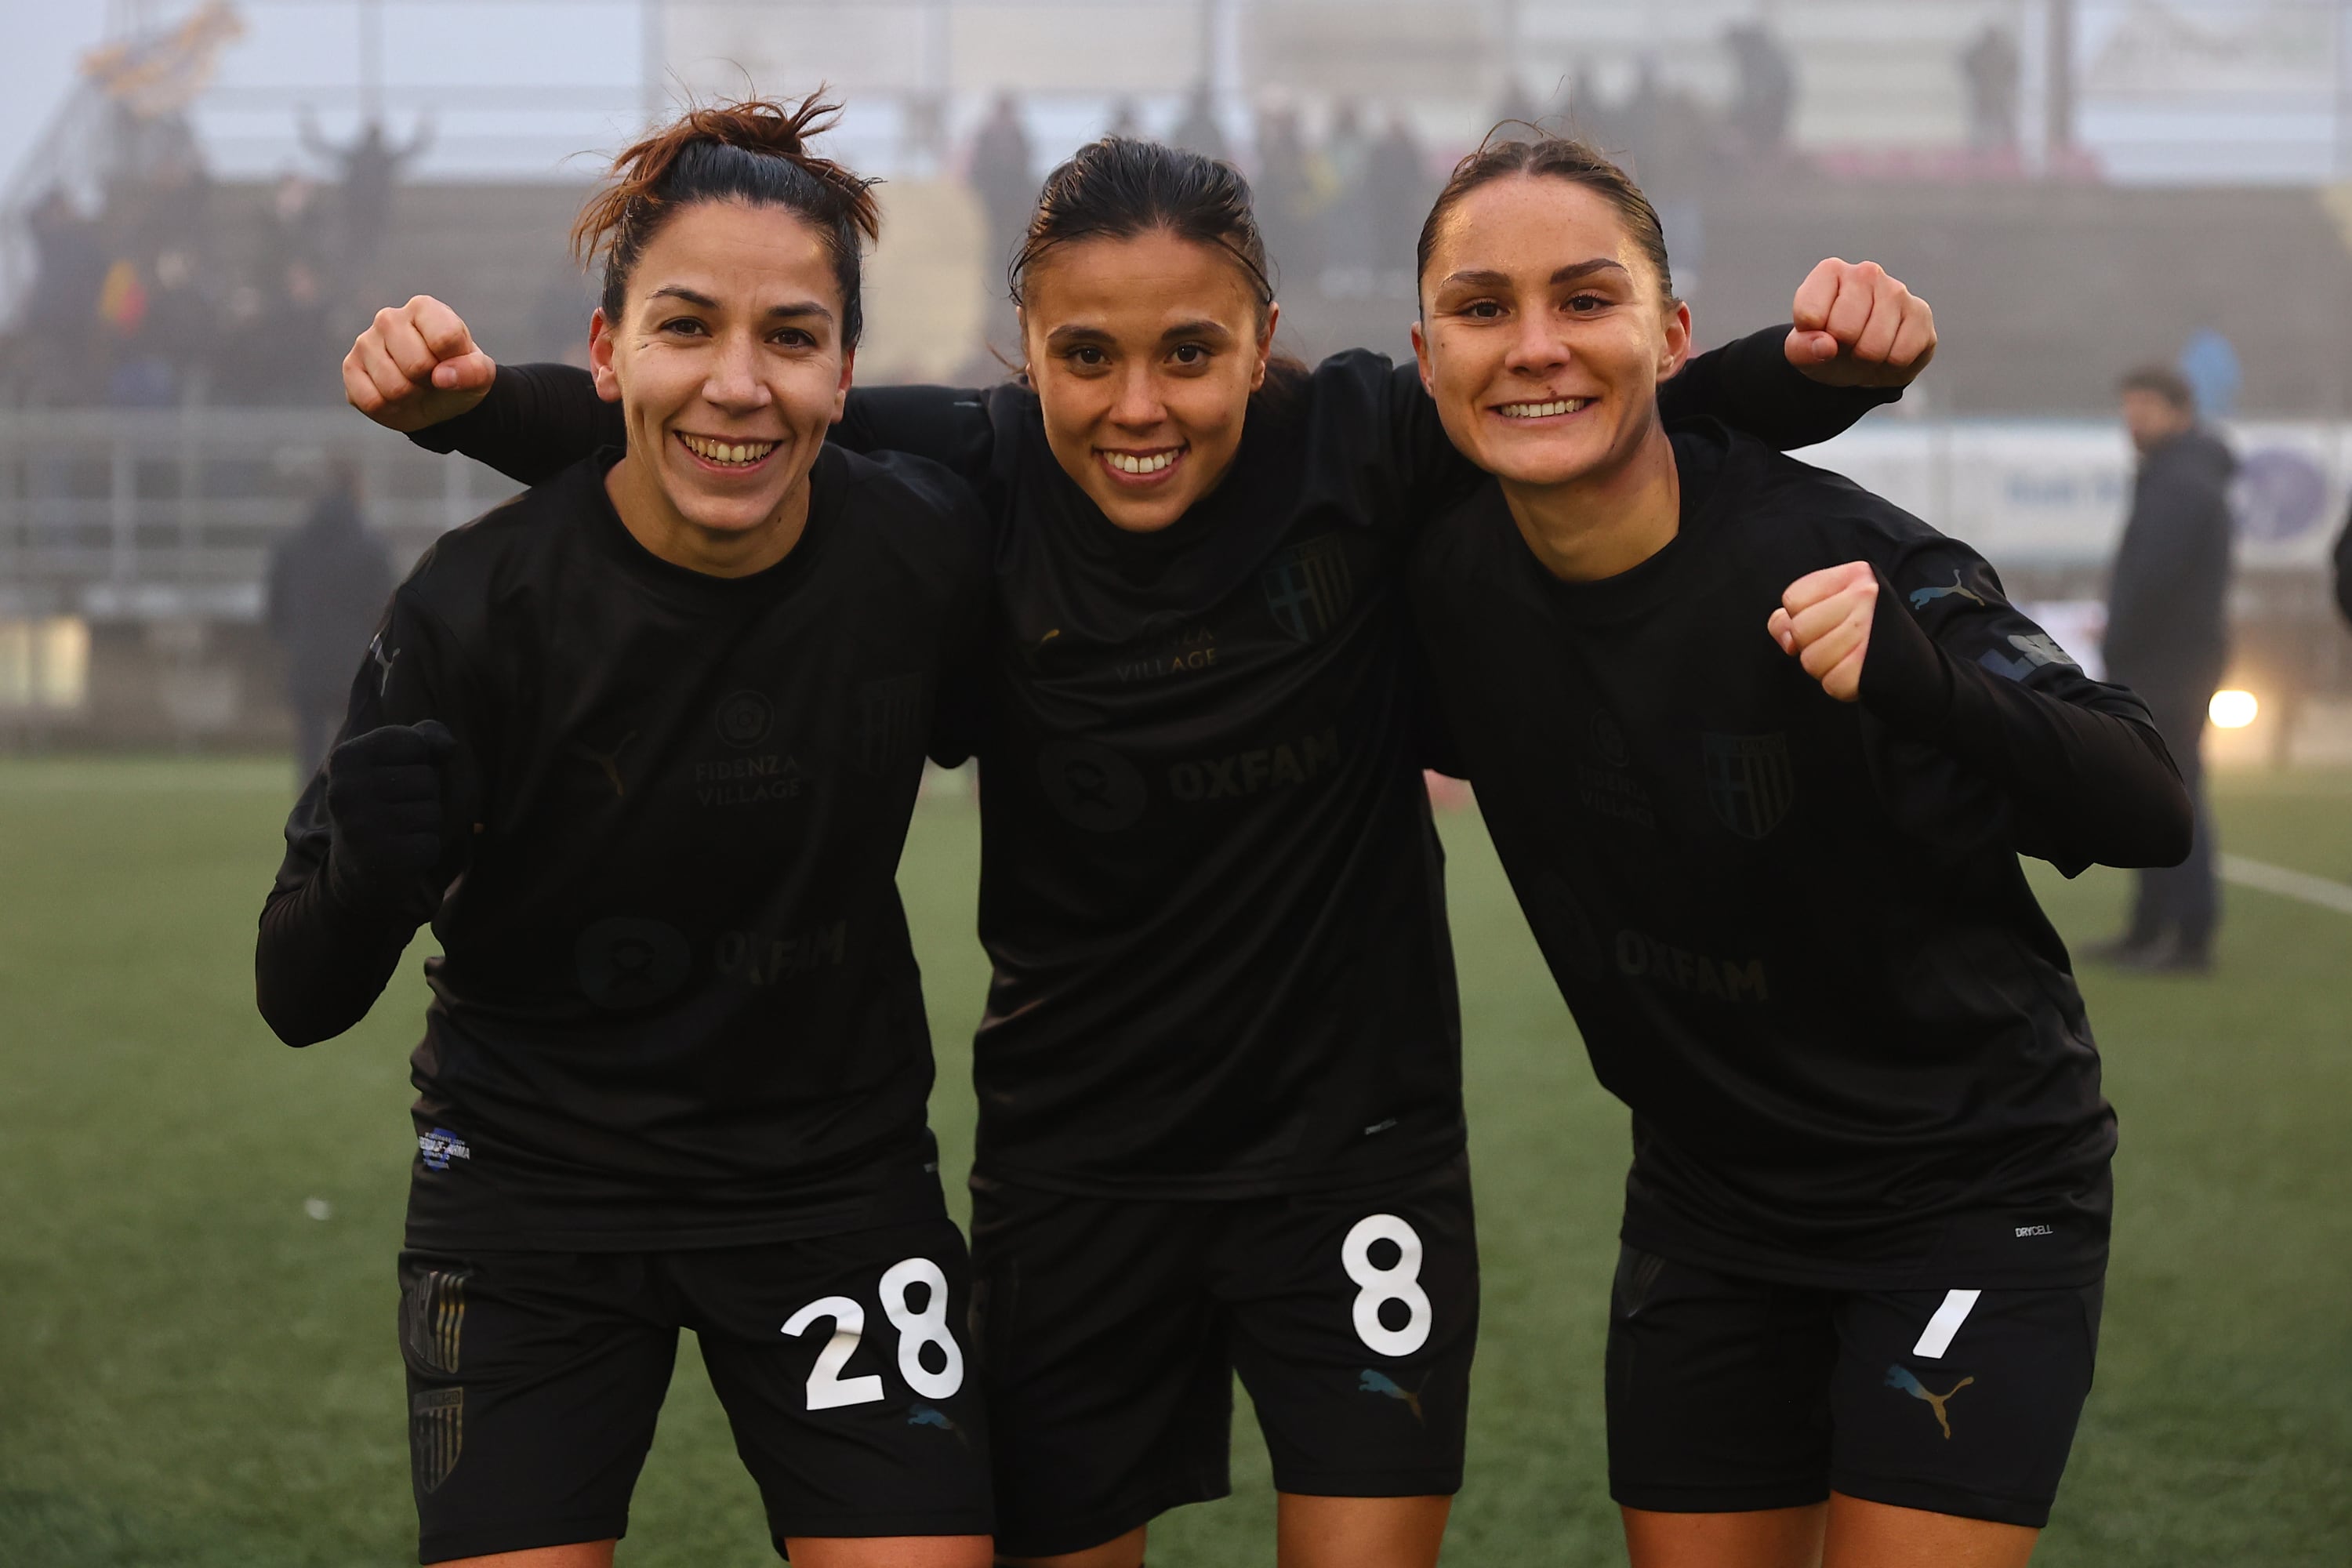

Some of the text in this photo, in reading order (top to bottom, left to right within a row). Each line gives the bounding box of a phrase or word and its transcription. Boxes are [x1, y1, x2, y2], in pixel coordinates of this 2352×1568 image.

[1116, 648, 1218, 684] VILLAGE
[695, 754, 799, 784] FIDENZA
[695, 777, 803, 808] VILLAGE
[1168, 724, 1341, 803] OXFAM
[1615, 927, 1769, 1004] OXFAM
[1341, 1213, 1433, 1357] 8
[780, 1257, 964, 1411] 28
